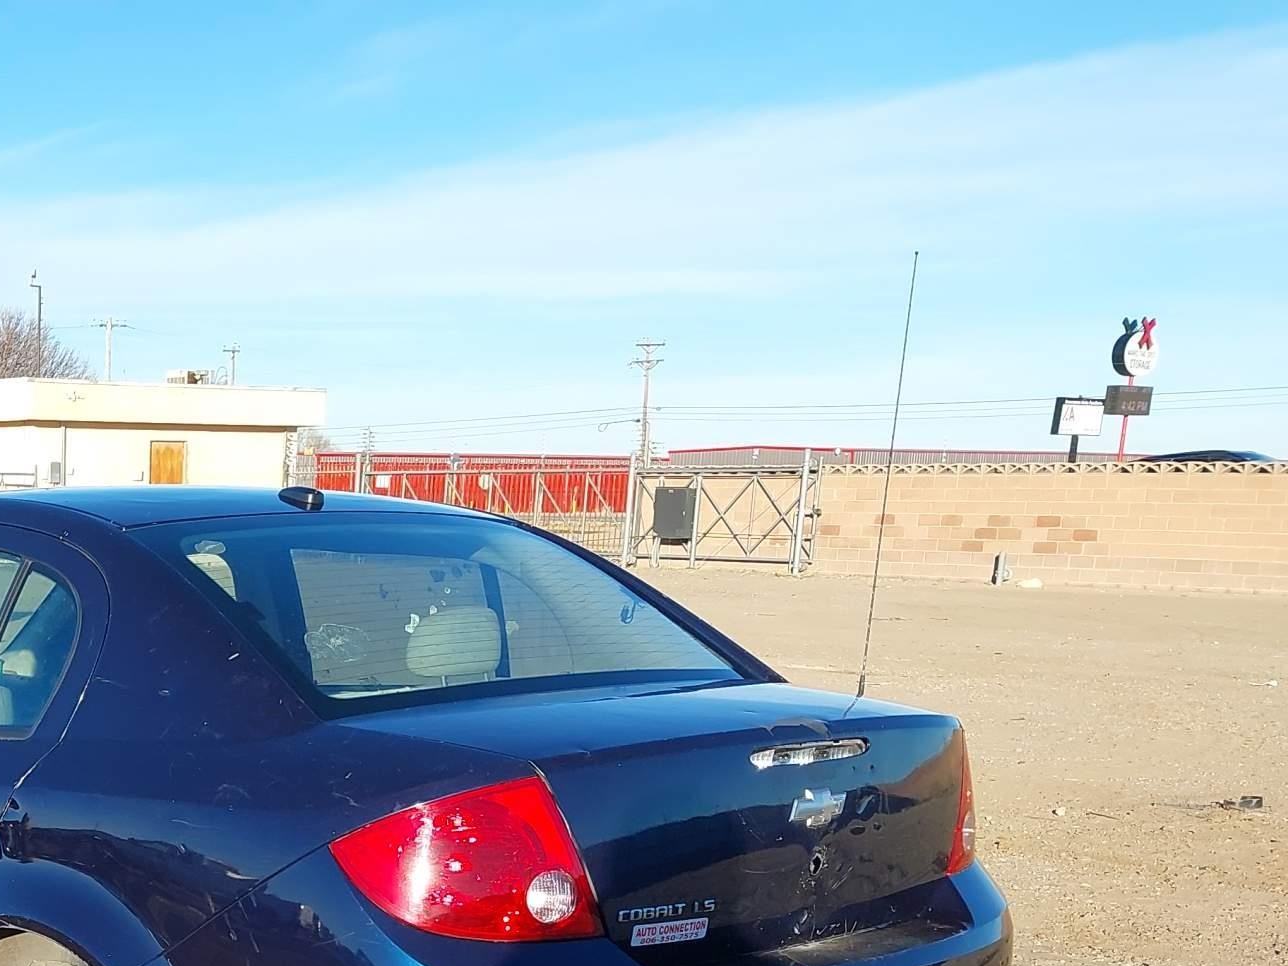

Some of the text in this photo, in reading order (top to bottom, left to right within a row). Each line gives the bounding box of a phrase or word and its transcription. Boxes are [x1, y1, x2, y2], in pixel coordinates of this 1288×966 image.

[617, 899, 715, 922] COBALT LS
[636, 920, 706, 937] AUTO CONNECTION
